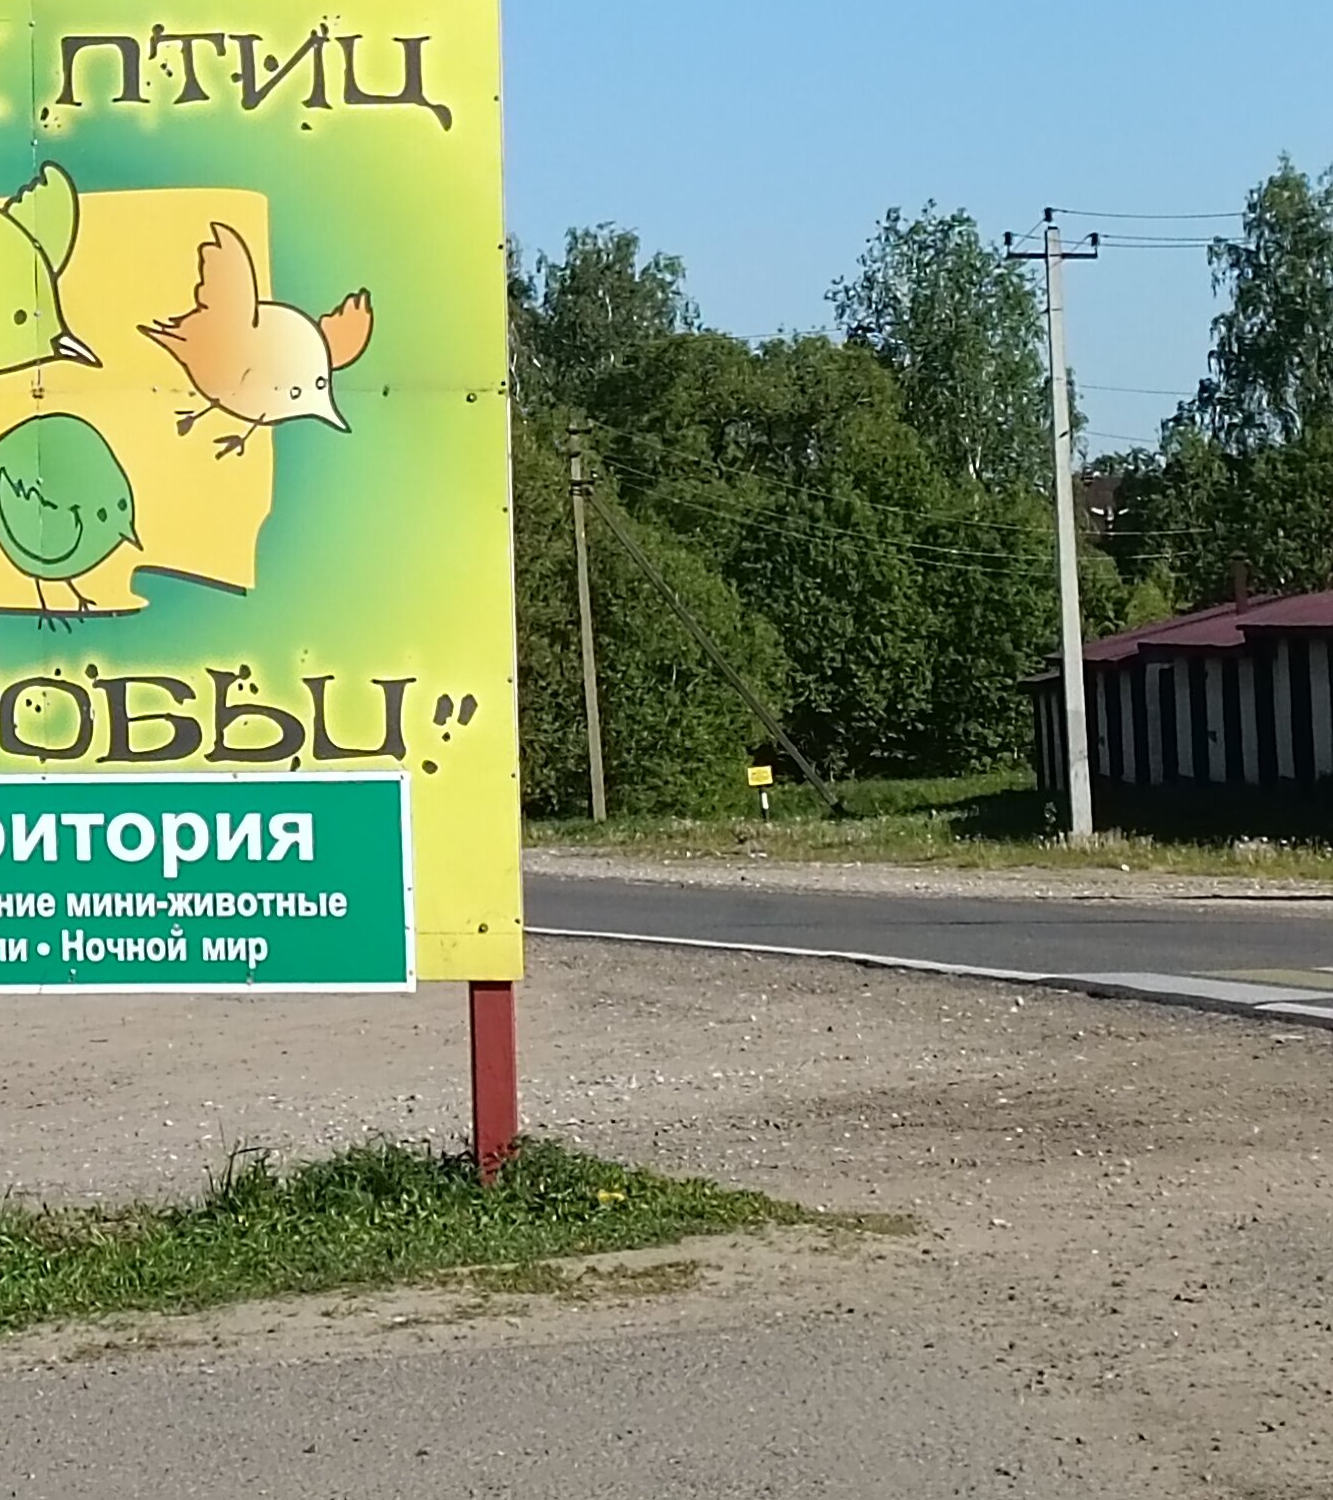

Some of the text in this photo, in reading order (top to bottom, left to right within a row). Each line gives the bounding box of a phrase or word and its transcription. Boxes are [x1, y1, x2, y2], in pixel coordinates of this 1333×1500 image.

[55, 24, 452, 131] ПТИЦ
[65, 892, 348, 918] мини-животные
[60, 929, 188, 962] Ночной
[201, 937, 269, 970] мир
